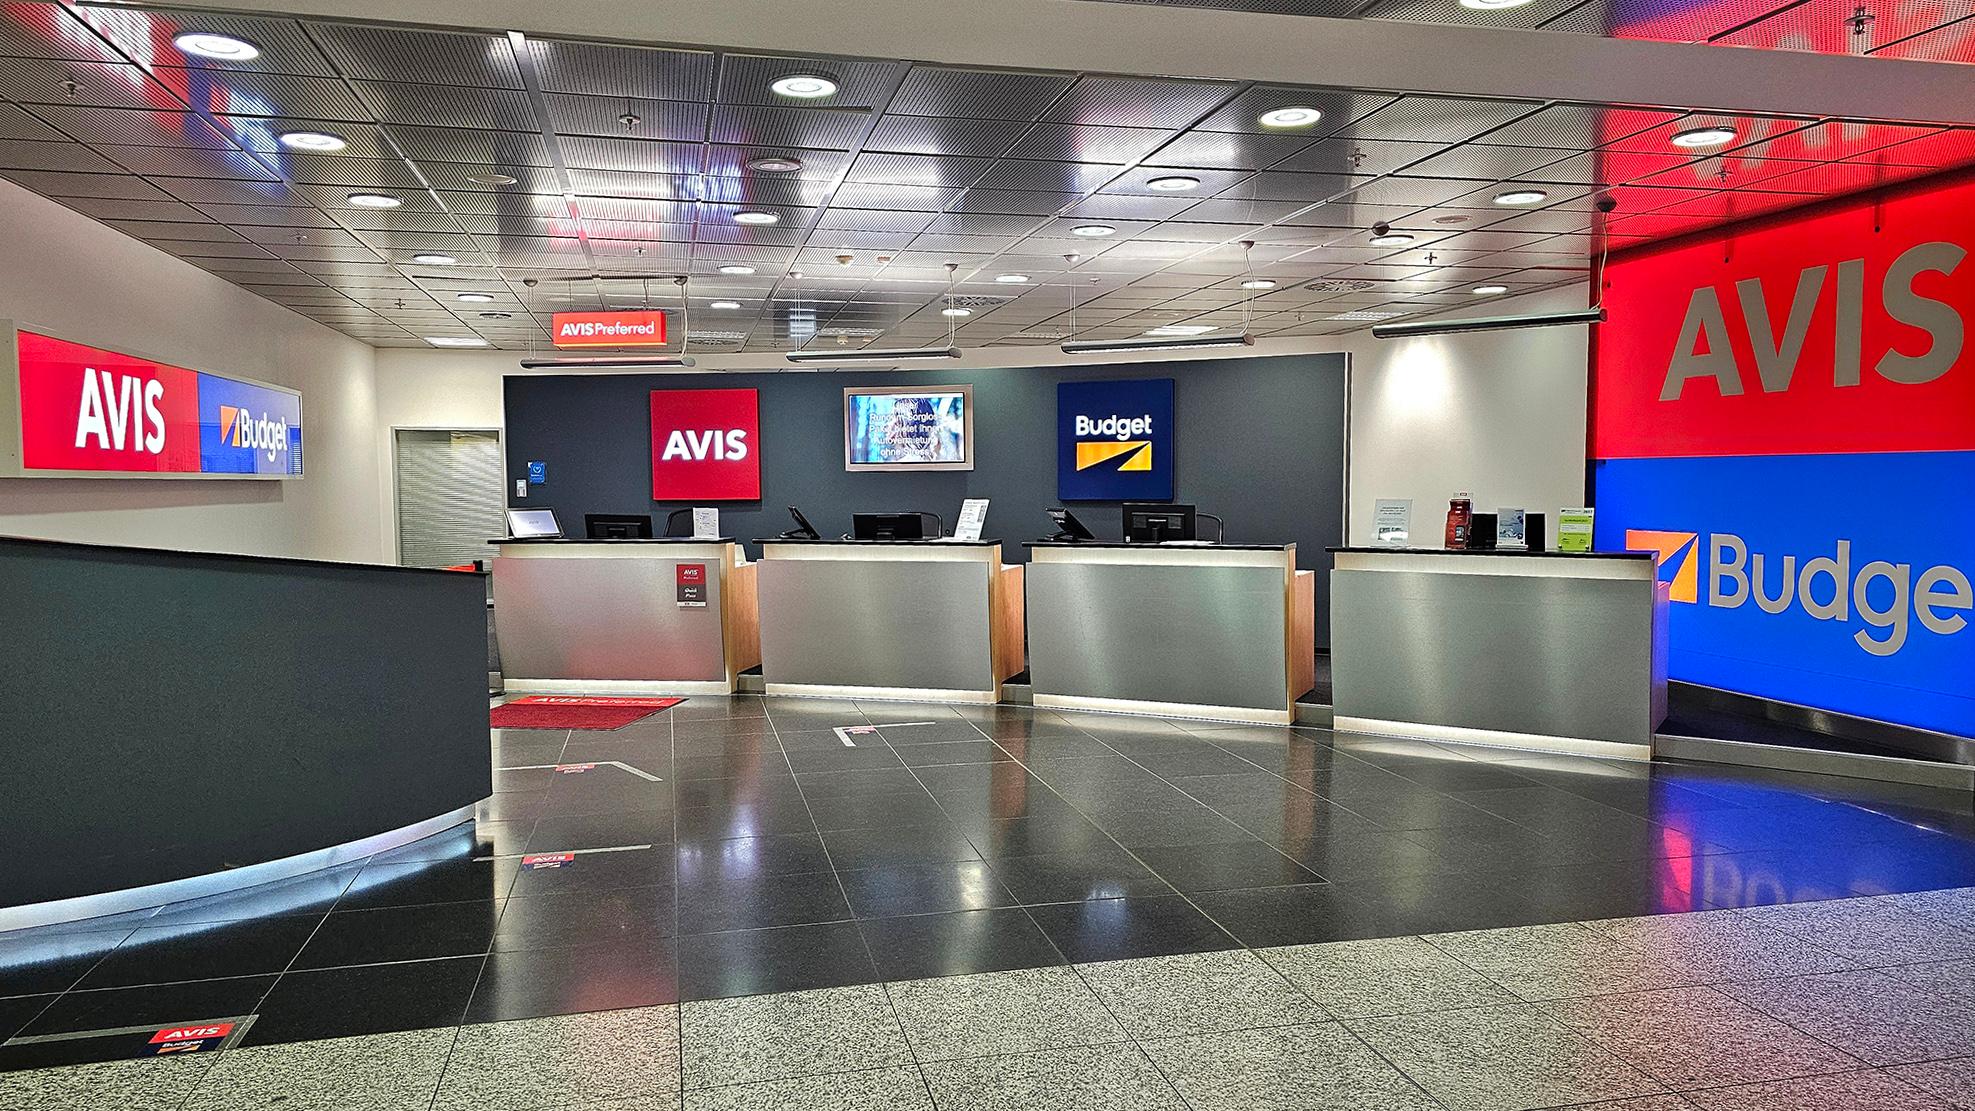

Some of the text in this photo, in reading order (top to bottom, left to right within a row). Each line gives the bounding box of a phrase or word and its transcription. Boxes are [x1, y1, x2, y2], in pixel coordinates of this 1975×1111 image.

[1658, 241, 1968, 402] AVIS
[75, 367, 166, 454] AVIS
[240, 407, 288, 462] Budget
[1075, 413, 1153, 441] Budget
[661, 429, 748, 461] AVIS
[161, 1039, 204, 1048] Budget
[164, 1026, 221, 1040] AVIS
